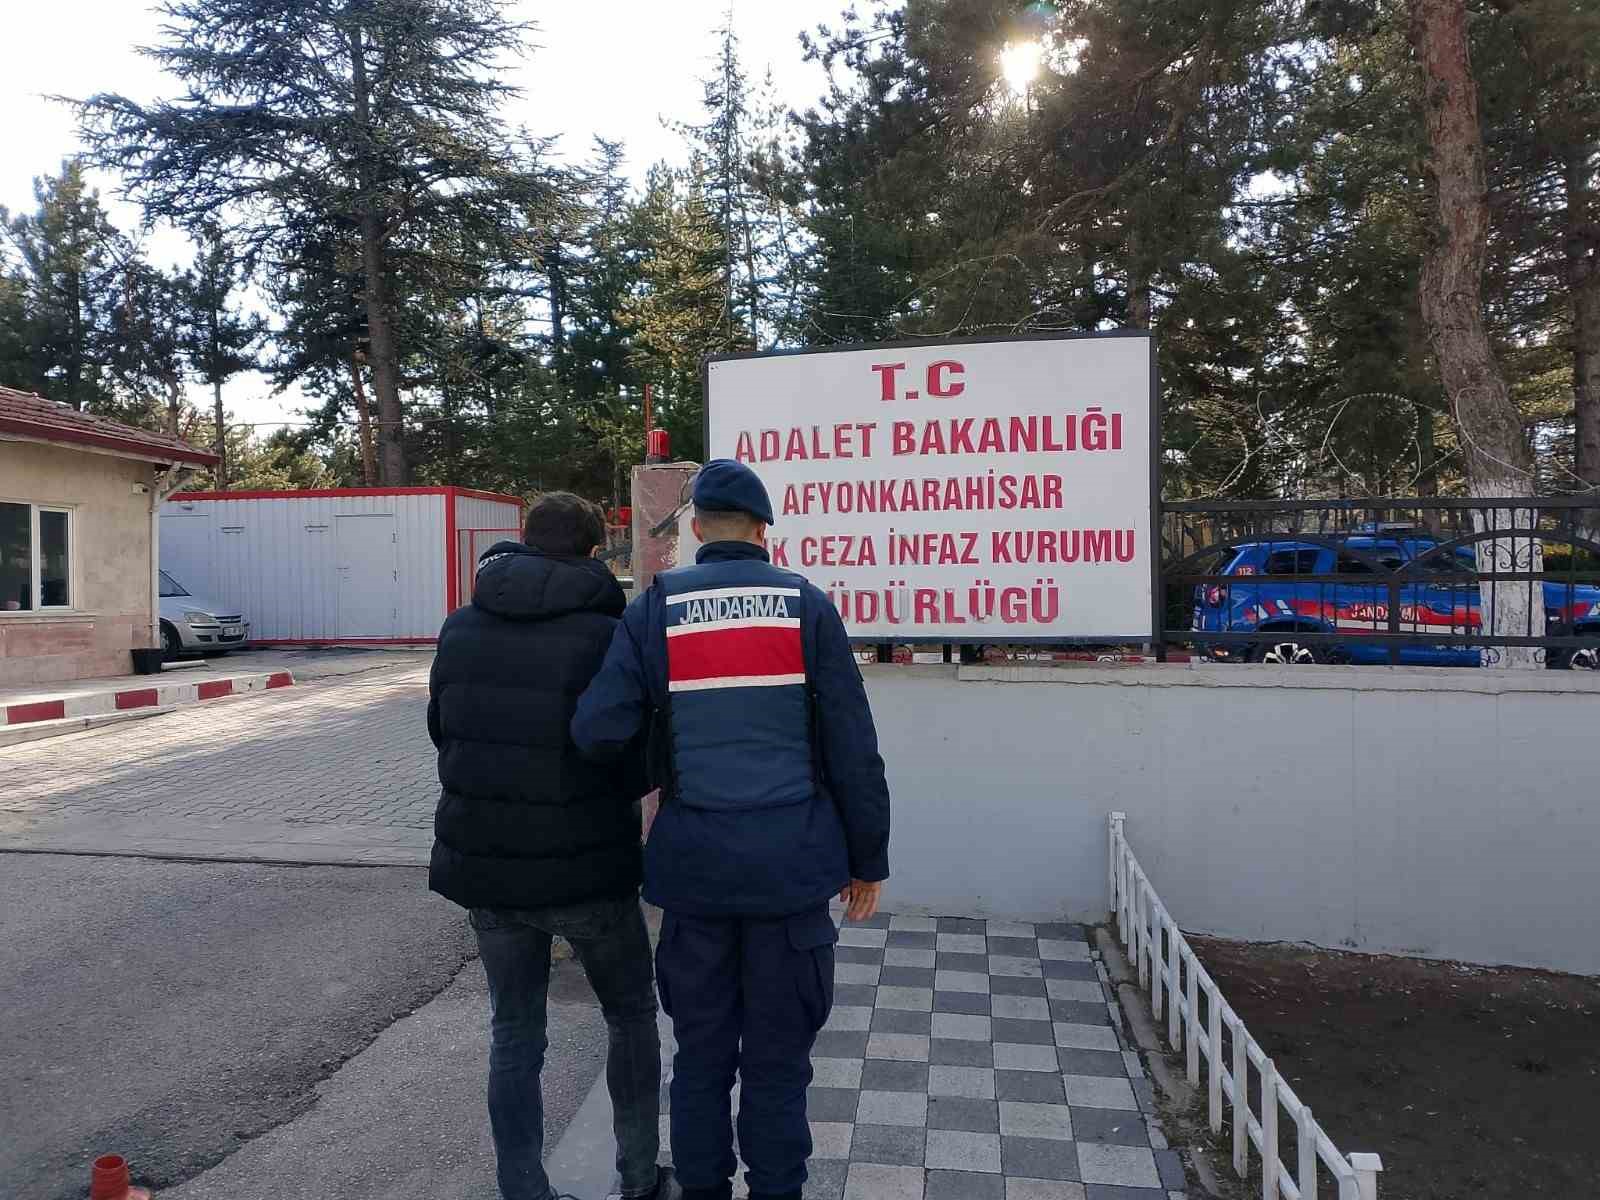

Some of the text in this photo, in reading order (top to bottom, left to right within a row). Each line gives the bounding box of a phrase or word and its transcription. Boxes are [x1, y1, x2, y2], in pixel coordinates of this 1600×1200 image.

[736, 406, 1123, 464] ADALET BAKANLIĞI
[782, 468, 1064, 516] AFYONKARAHİSAR
[800, 535, 877, 568] CEZA
[888, 527, 980, 566] İNFAZ
[991, 528, 1136, 563] KURUMU
[679, 594, 790, 625] JANDARMA
[827, 577, 1060, 626] ÜDÜRLÜGÜ
